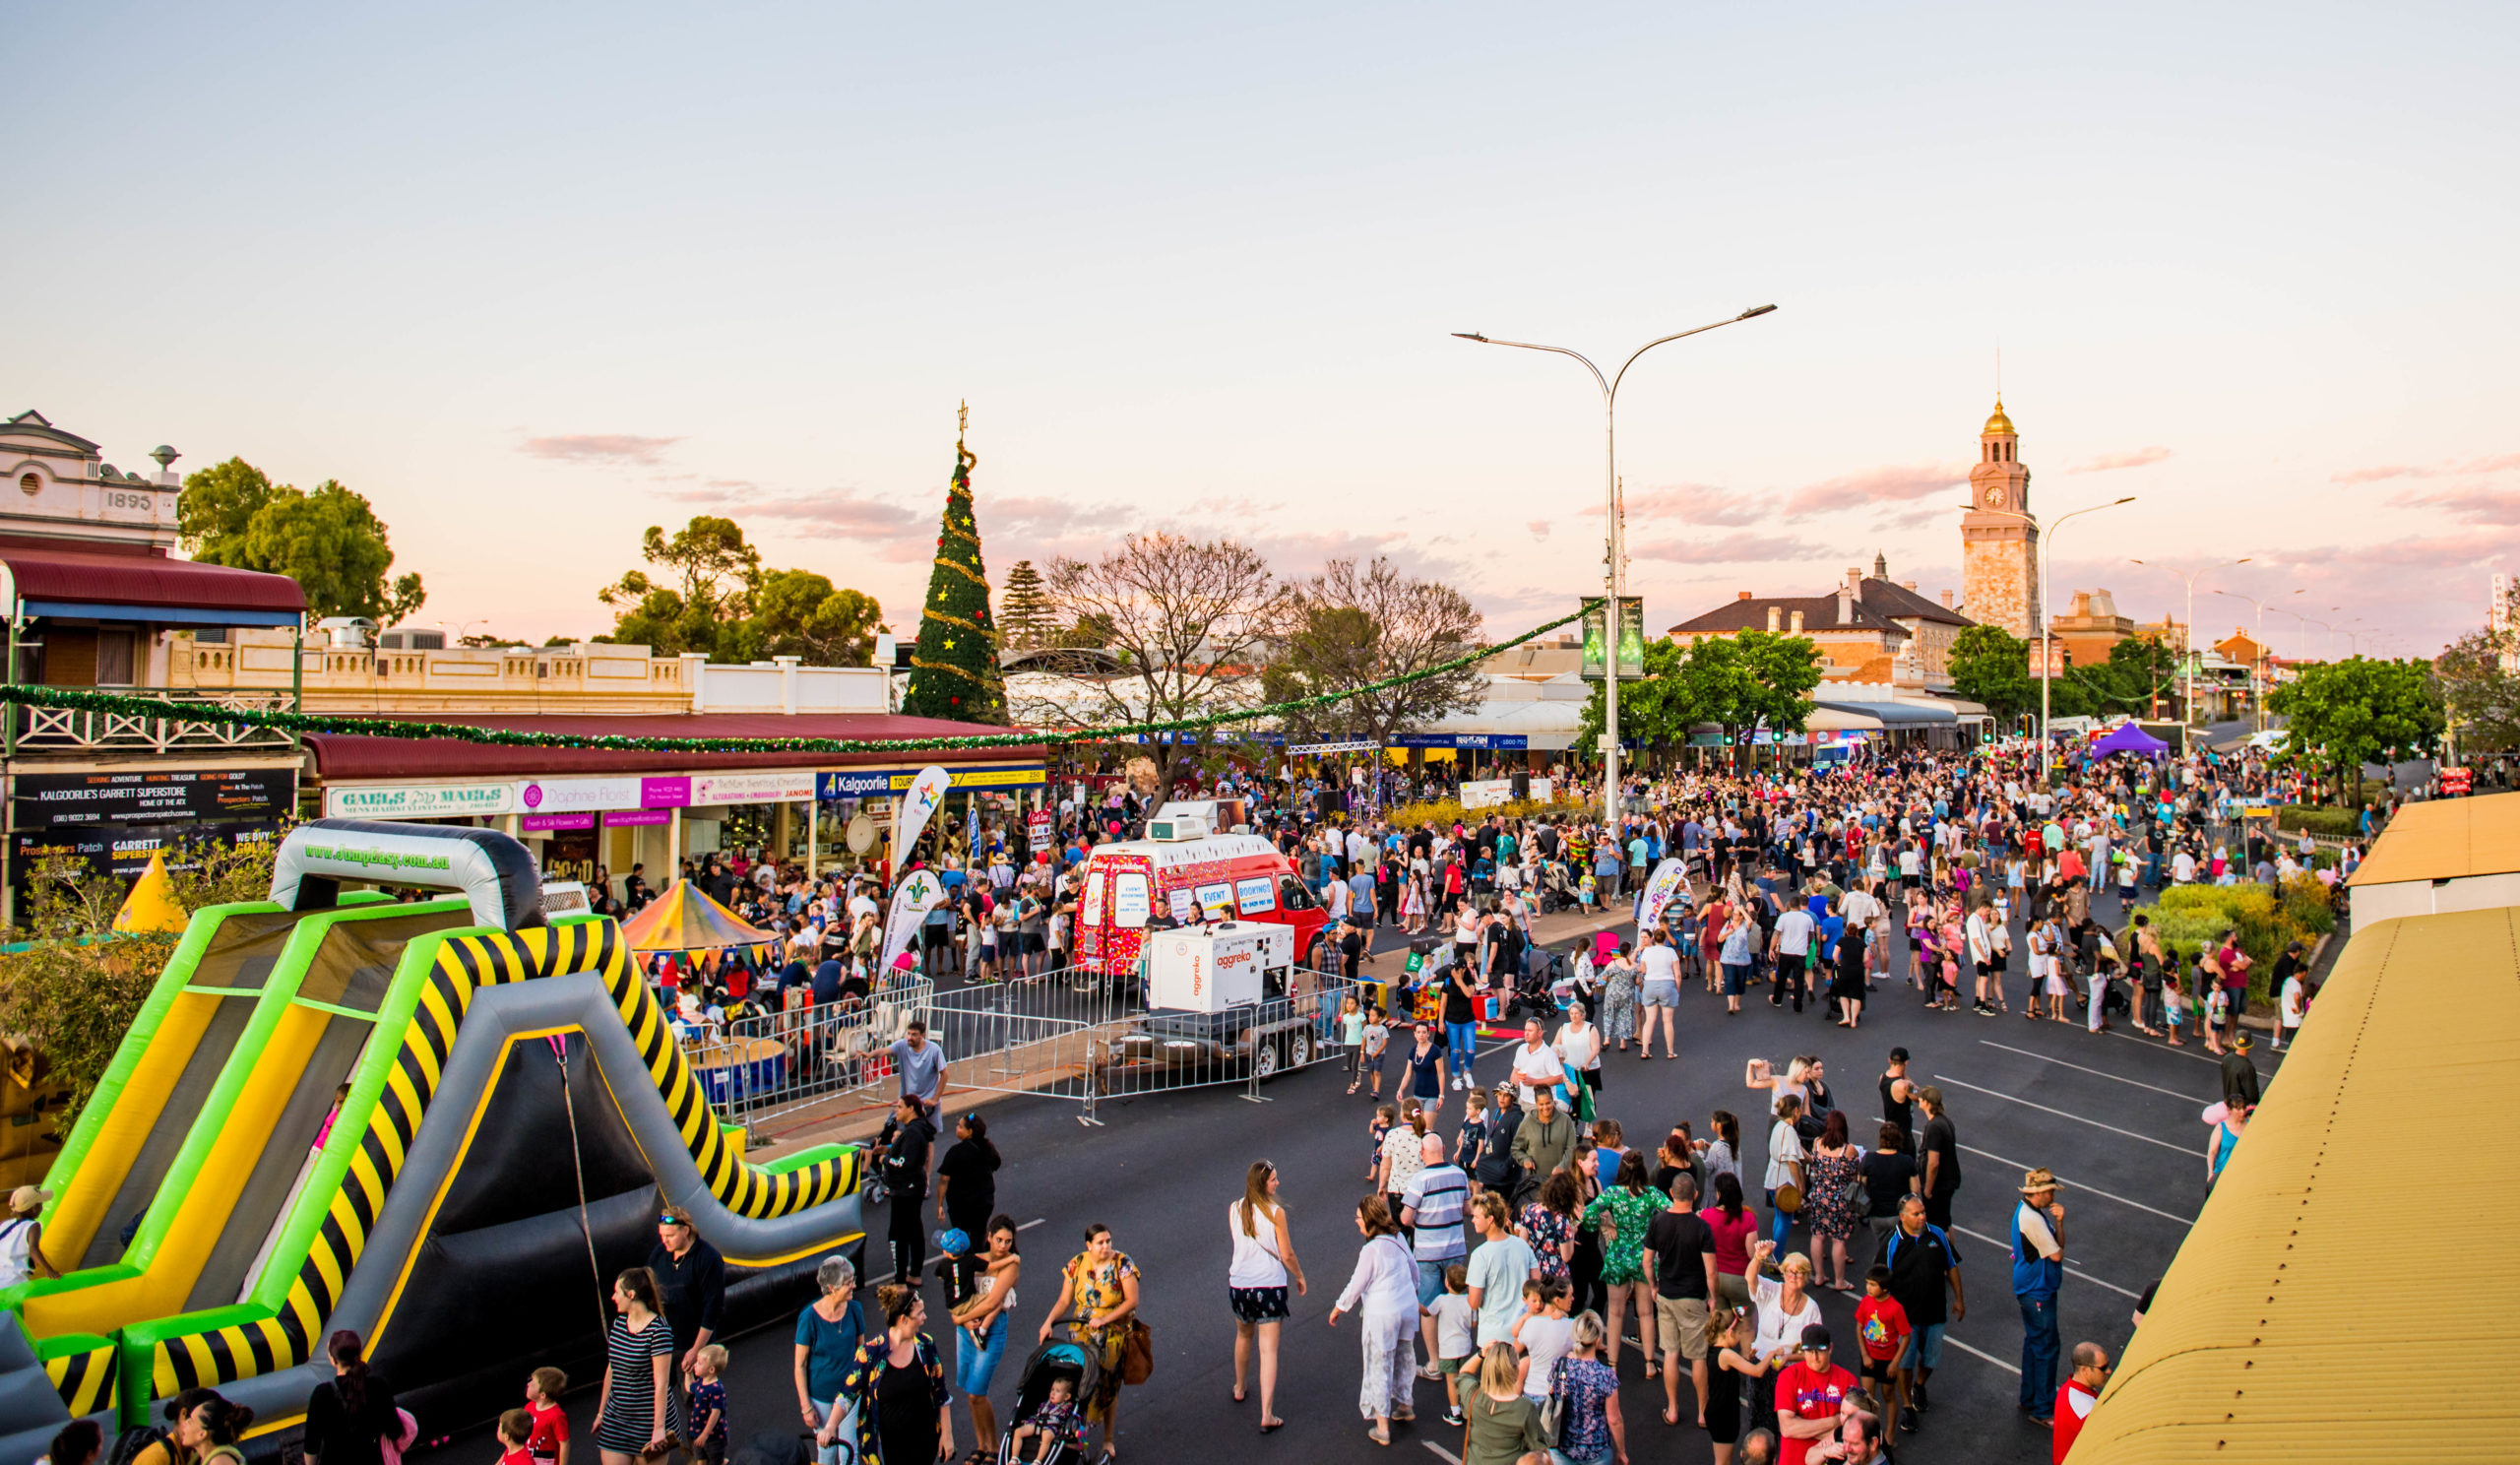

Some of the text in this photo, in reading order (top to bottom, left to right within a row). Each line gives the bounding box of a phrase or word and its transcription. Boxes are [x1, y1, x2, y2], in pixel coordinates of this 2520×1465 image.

[108, 492, 151, 511] 1895
[110, 775, 143, 784] ADVENTURE
[170, 774, 197, 783] TREASURE
[838, 776, 888, 796] Kalgoorlie
[39, 787, 187, 801] KALGOORLIE'S GARRETT SUPERSTORE
[343, 791, 407, 806] GAELS
[439, 788, 501, 803] MAELS
[548, 788, 596, 807] Daphne
[599, 786, 630, 802] Florist
[712, 791, 746, 800] ALTERATIONS
[785, 789, 814, 798] JANOME
[527, 818, 541, 828] Fresh
[555, 816, 575, 827] Flowers
[21, 837, 33, 846] the
[77, 842, 103, 854] Patch
[112, 838, 162, 852] GARRETT
[305, 844, 450, 869] www.JumpEasy.com.au
[1204, 890, 1226, 903] EVENT
[1238, 883, 1271, 898] BOOKINGS
[1217, 948, 1251, 970] aggreko
[1192, 955, 1202, 996] aggreko
